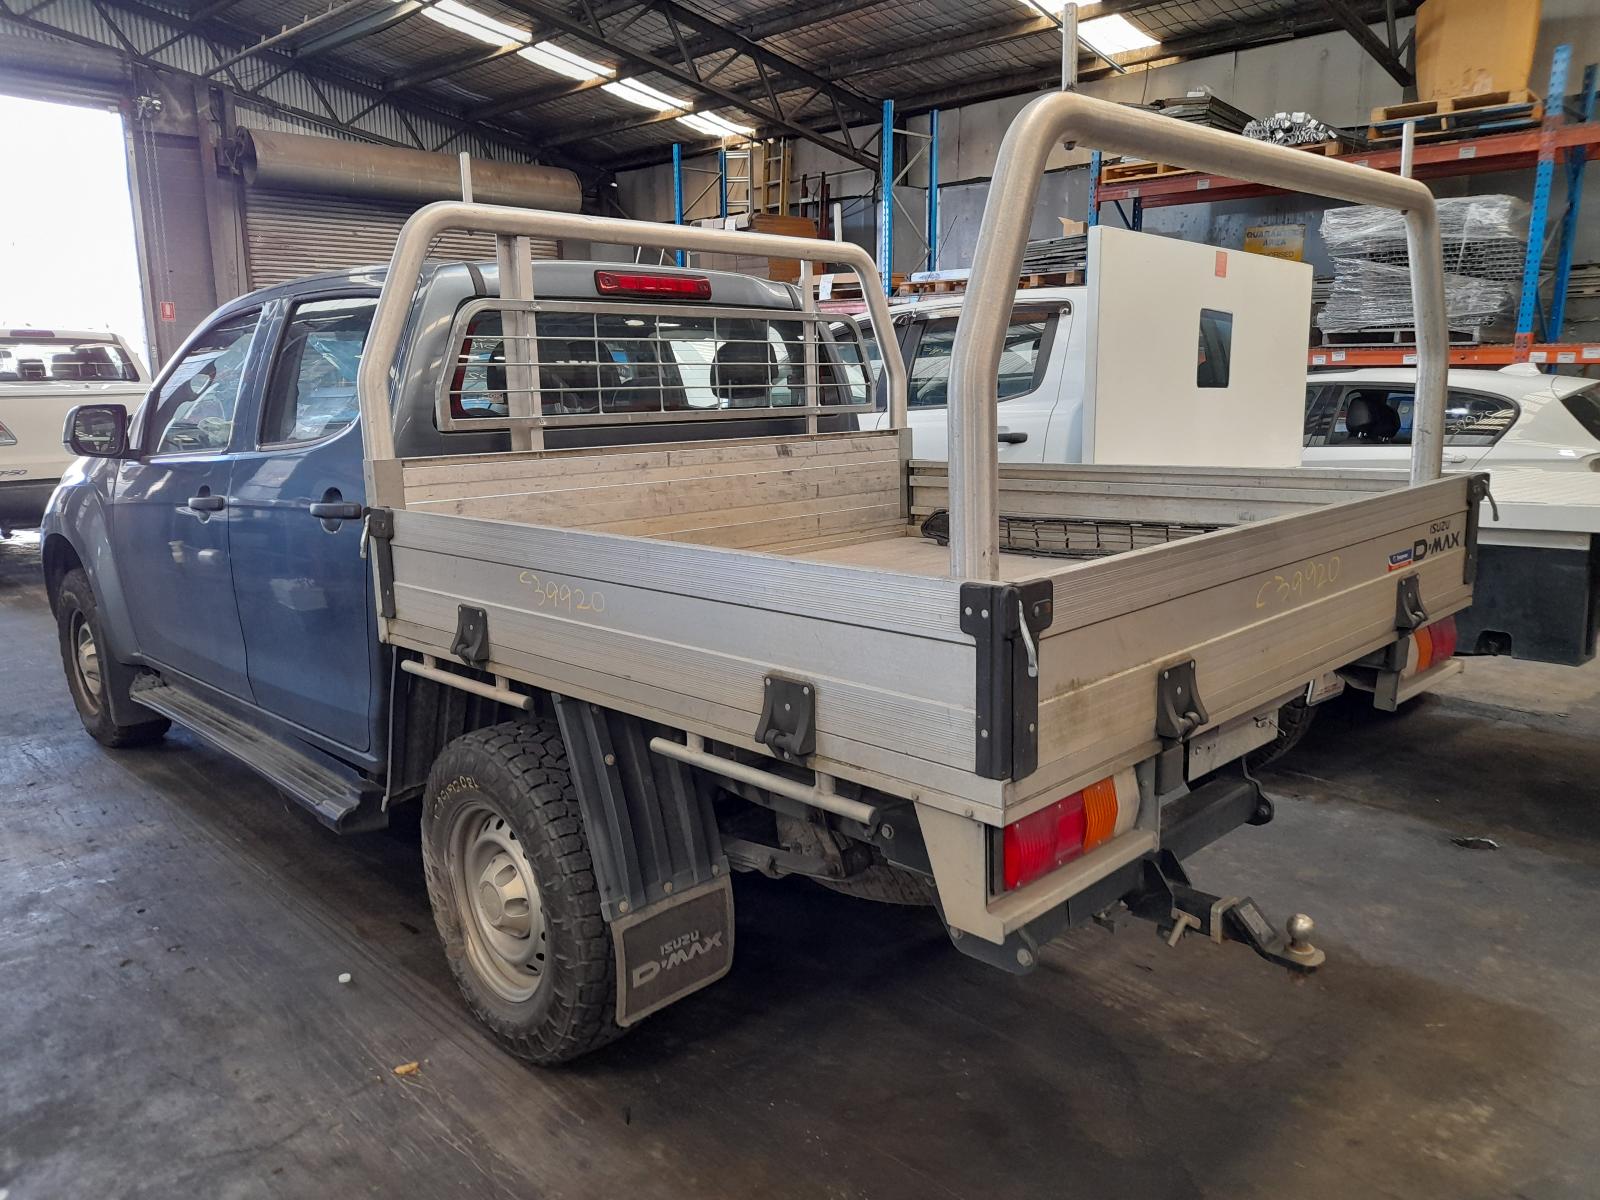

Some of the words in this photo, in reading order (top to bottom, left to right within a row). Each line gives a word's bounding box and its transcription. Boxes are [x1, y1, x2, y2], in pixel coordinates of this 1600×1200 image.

[1429, 519, 1451, 534] ISUZU
[1412, 530, 1460, 562] D-MAX
[519, 571, 605, 613] C39920
[659, 930, 700, 956] ISUZU
[632, 930, 723, 989] D-MAX
